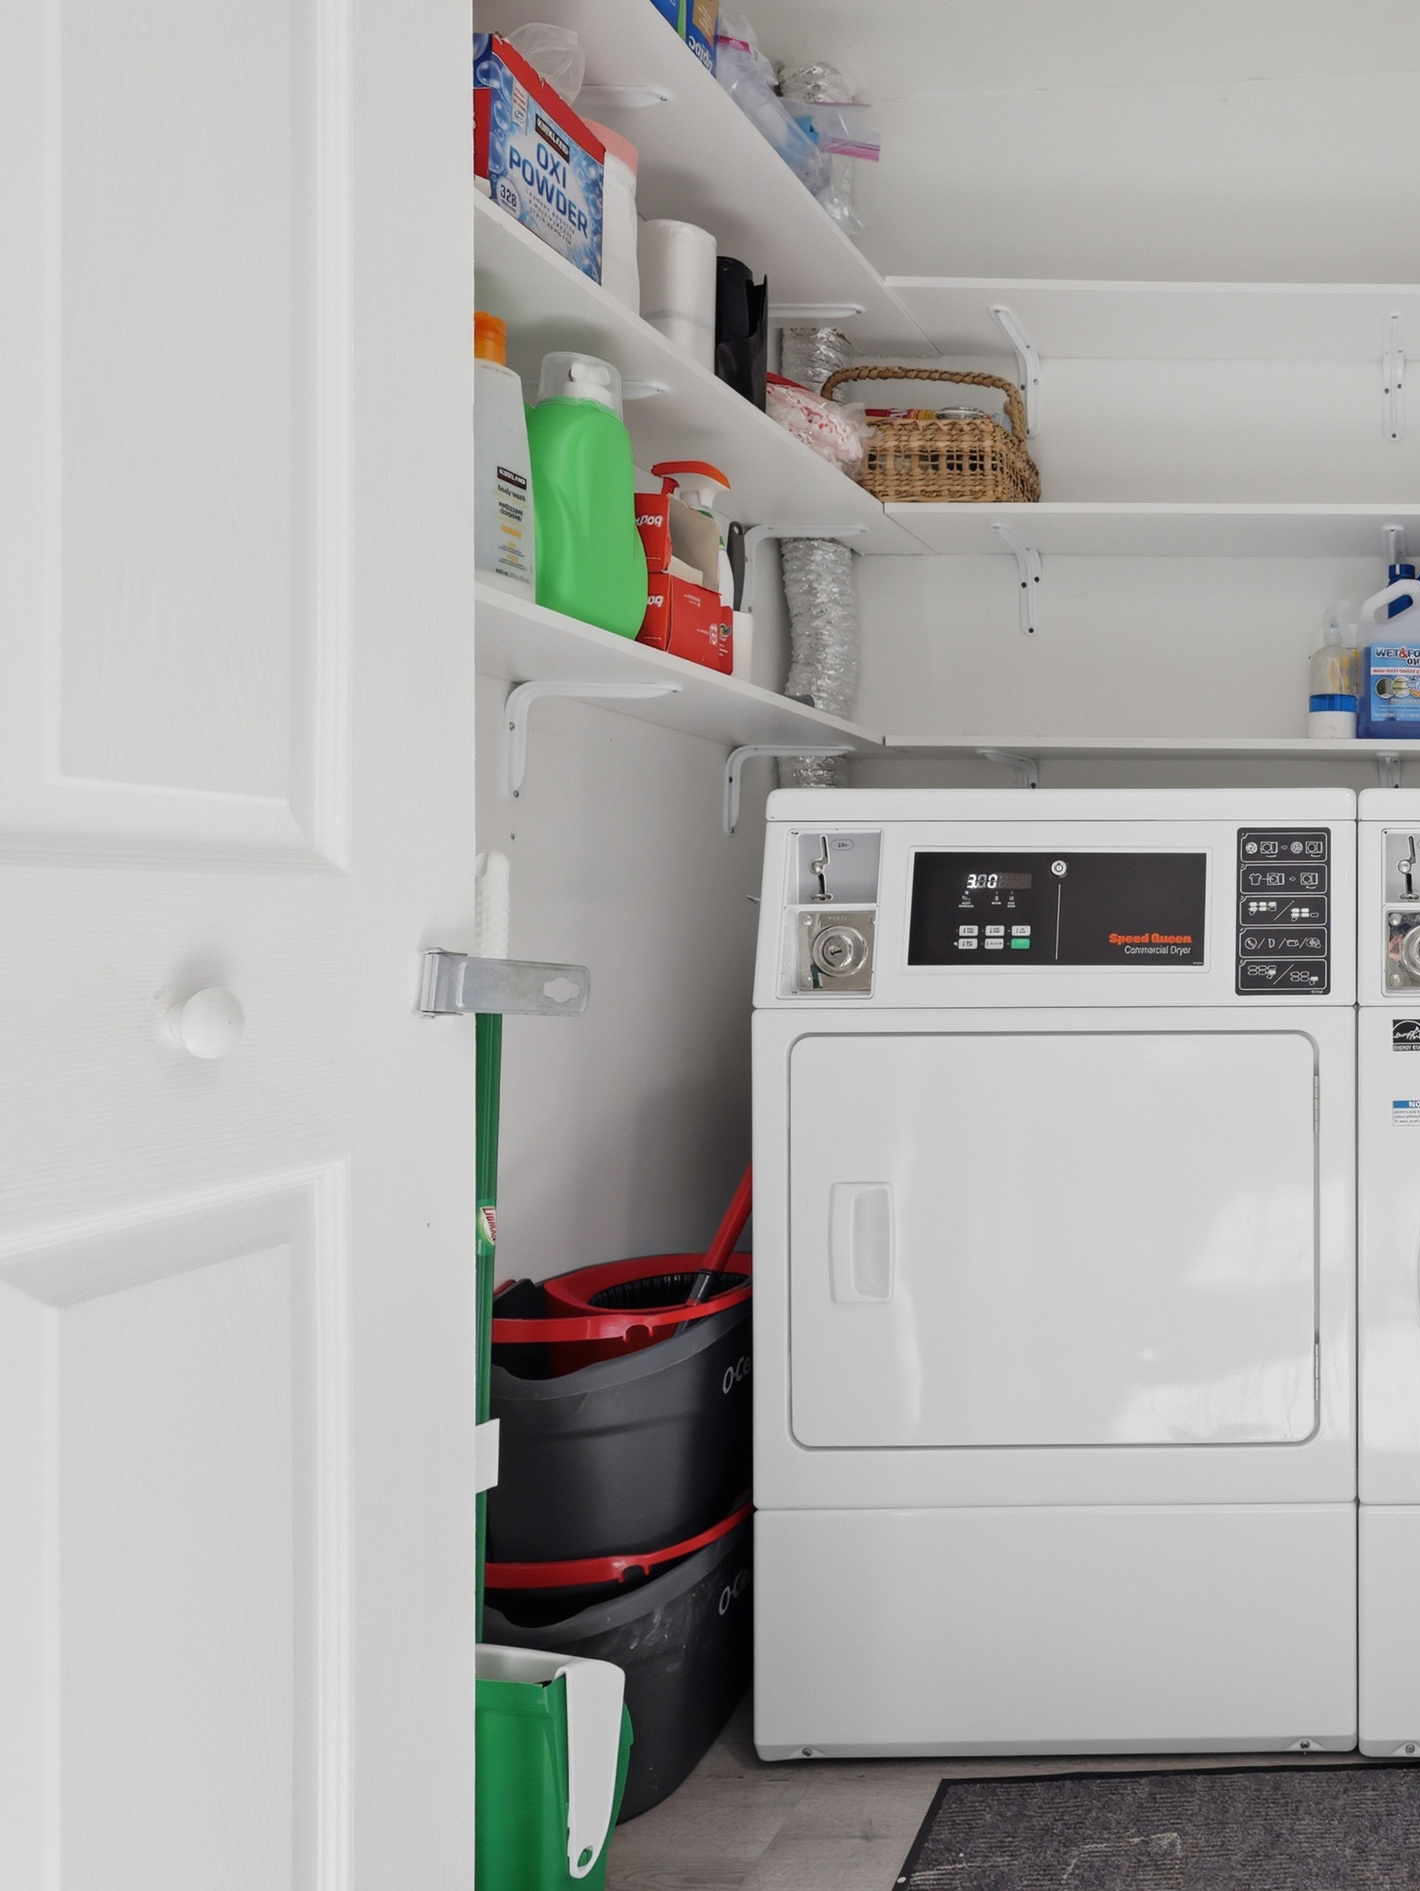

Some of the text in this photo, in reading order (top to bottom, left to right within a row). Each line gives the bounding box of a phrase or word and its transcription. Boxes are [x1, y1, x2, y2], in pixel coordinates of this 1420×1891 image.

[537, 143, 566, 189] OXI
[500, 184, 517, 207] 328
[509, 145, 588, 239] POWDER
[1376, 648, 1398, 658] WET
[1109, 933, 1192, 946] Speed Queen
[1124, 945, 1191, 956] Commercial Dryer
